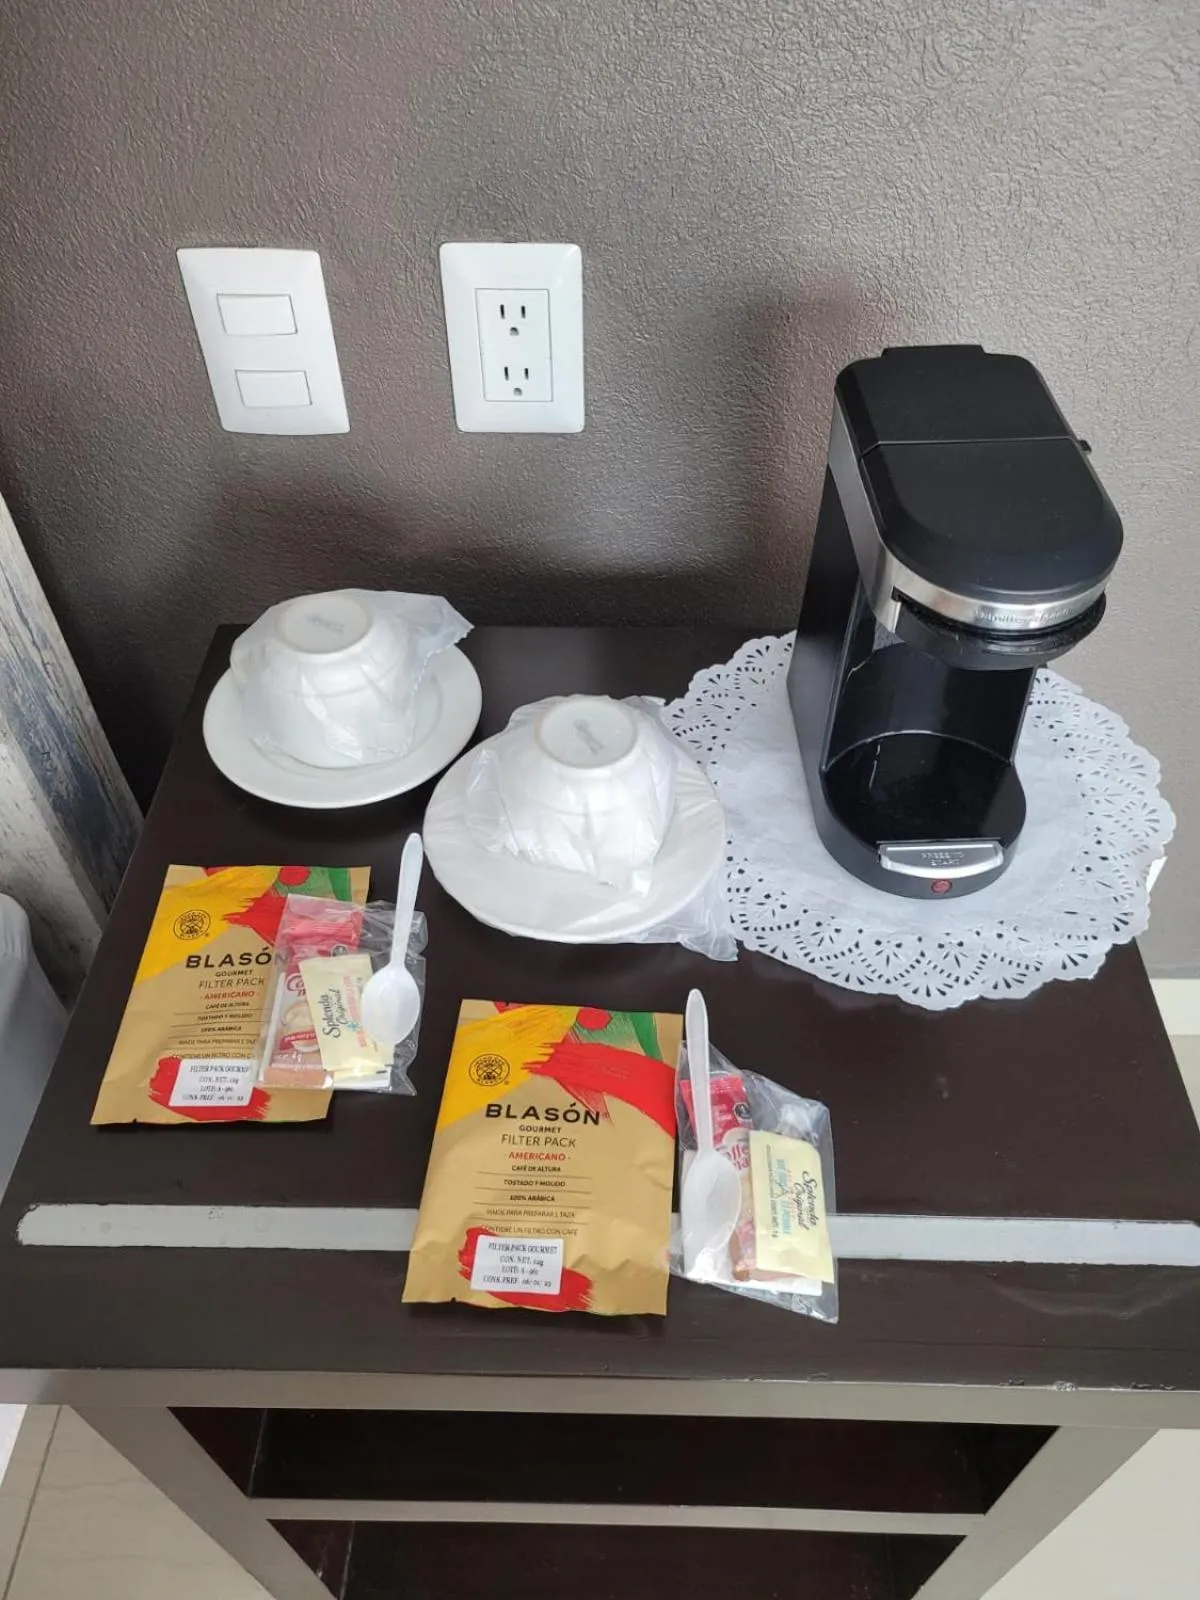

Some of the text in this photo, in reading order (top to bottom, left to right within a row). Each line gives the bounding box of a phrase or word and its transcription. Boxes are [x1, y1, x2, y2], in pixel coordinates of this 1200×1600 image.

[215, 969, 253, 977] GOURMET
[198, 977, 265, 989] FILTER PACK
[204, 990, 255, 1000] AMERICANO
[329, 988, 348, 1025] Original
[319, 994, 341, 1038] Splenda
[485, 1102, 600, 1126] BLASÓN
[518, 1124, 562, 1134] GOURMET
[501, 1133, 576, 1148] FILTER PACK
[508, 1151, 566, 1161] AMERICANO
[802, 1170, 819, 1226] Splenda
[793, 1181, 810, 1232] Original
